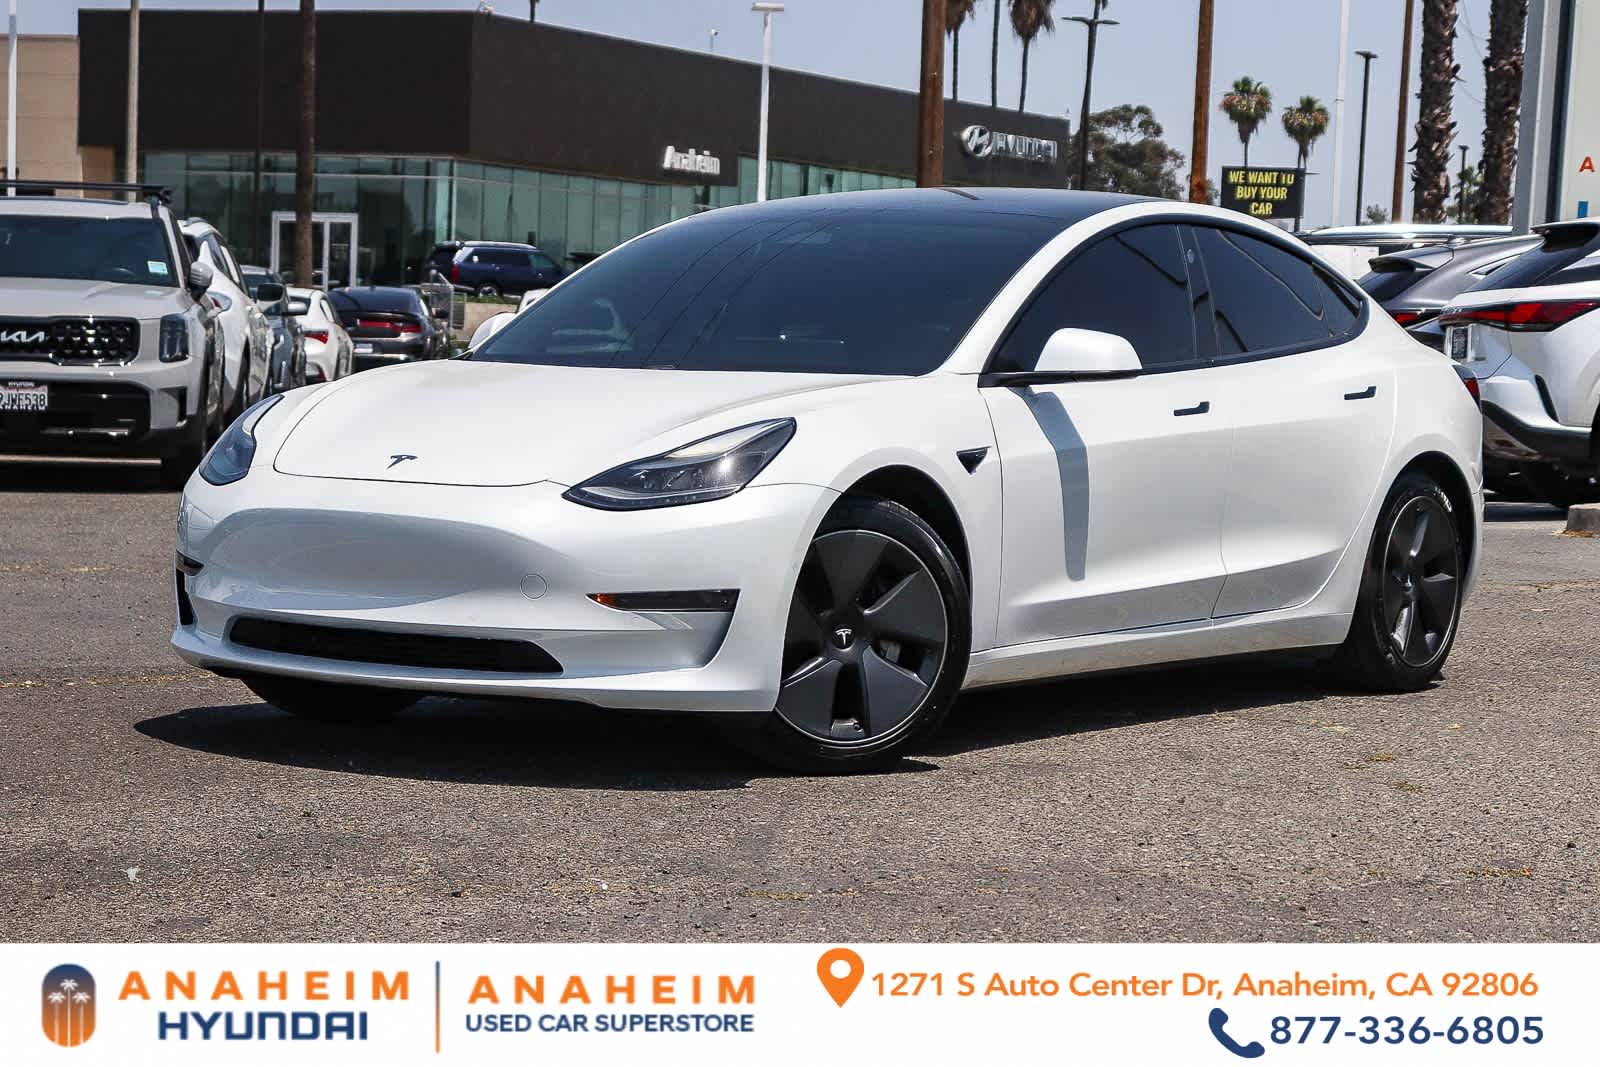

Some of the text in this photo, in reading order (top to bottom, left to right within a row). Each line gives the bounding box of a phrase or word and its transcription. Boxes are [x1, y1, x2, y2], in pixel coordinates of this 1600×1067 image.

[663, 145, 720, 175] Anaheim
[1228, 170, 1246, 184] WE
[1248, 171, 1279, 184] WANT
[1236, 185, 1288, 200] BUY YOUR
[1250, 202, 1273, 215] CAR
